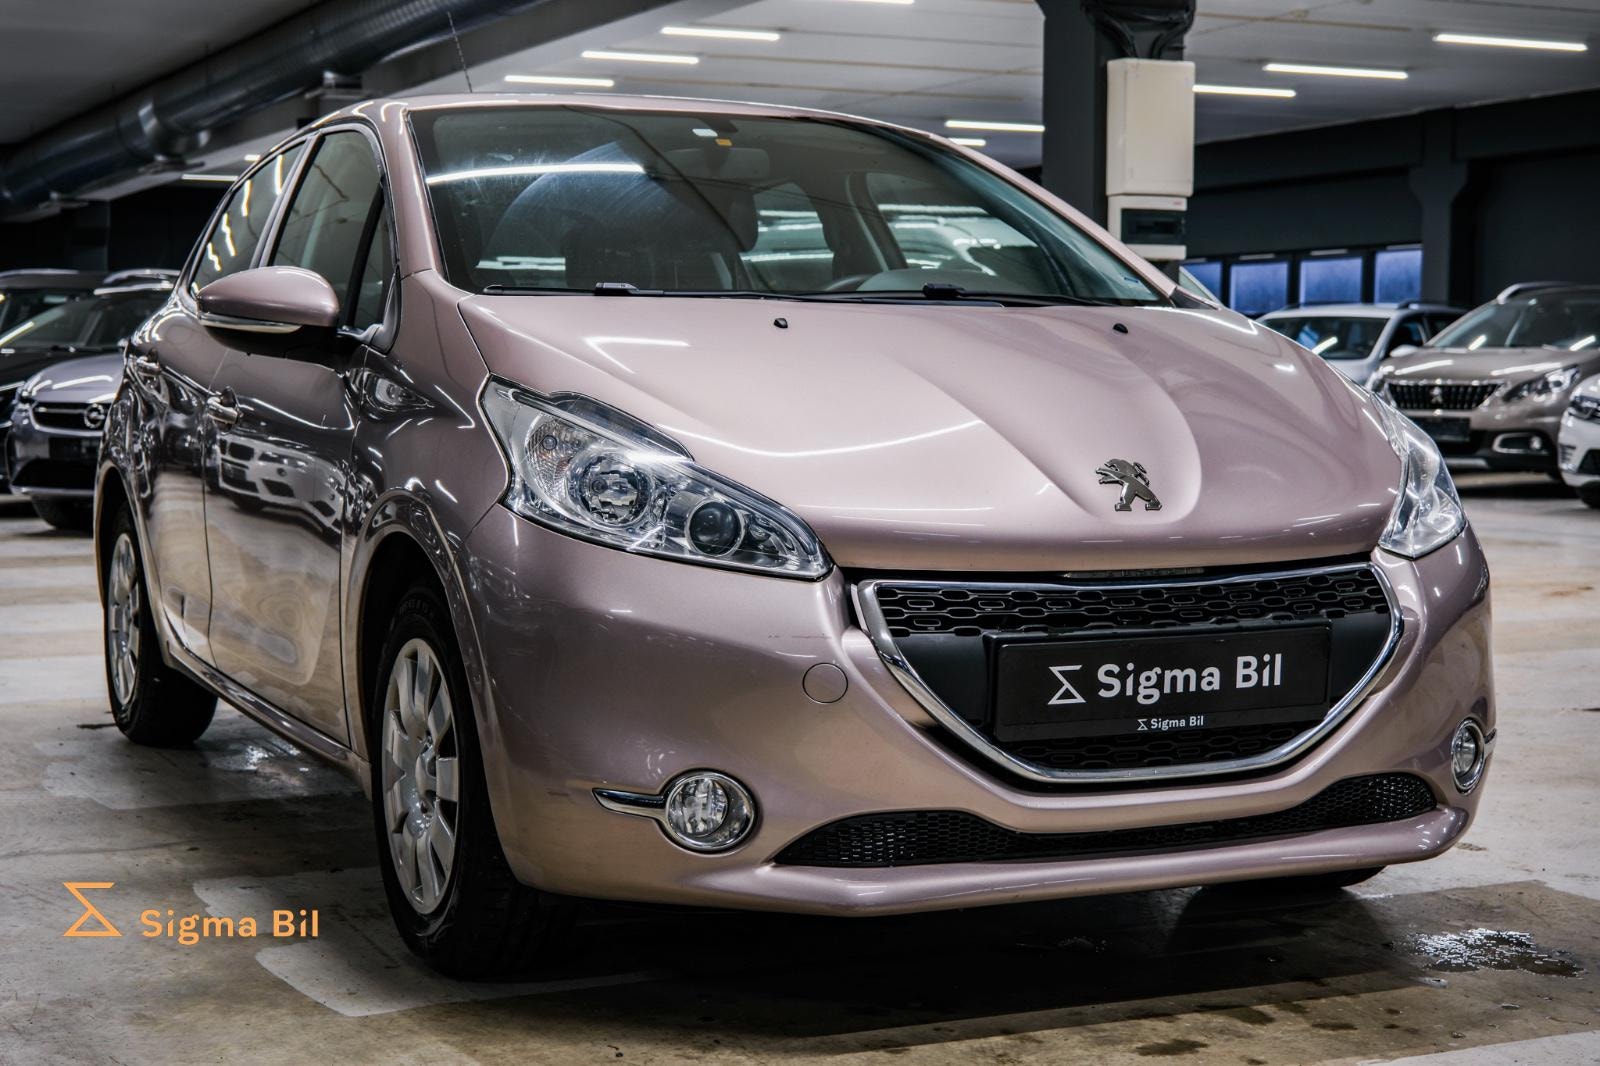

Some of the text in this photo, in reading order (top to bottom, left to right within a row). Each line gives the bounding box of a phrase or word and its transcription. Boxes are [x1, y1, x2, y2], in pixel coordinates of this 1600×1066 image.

[1097, 653, 1282, 704] Sigma Bil
[1150, 715, 1204, 731] Sigma Bil
